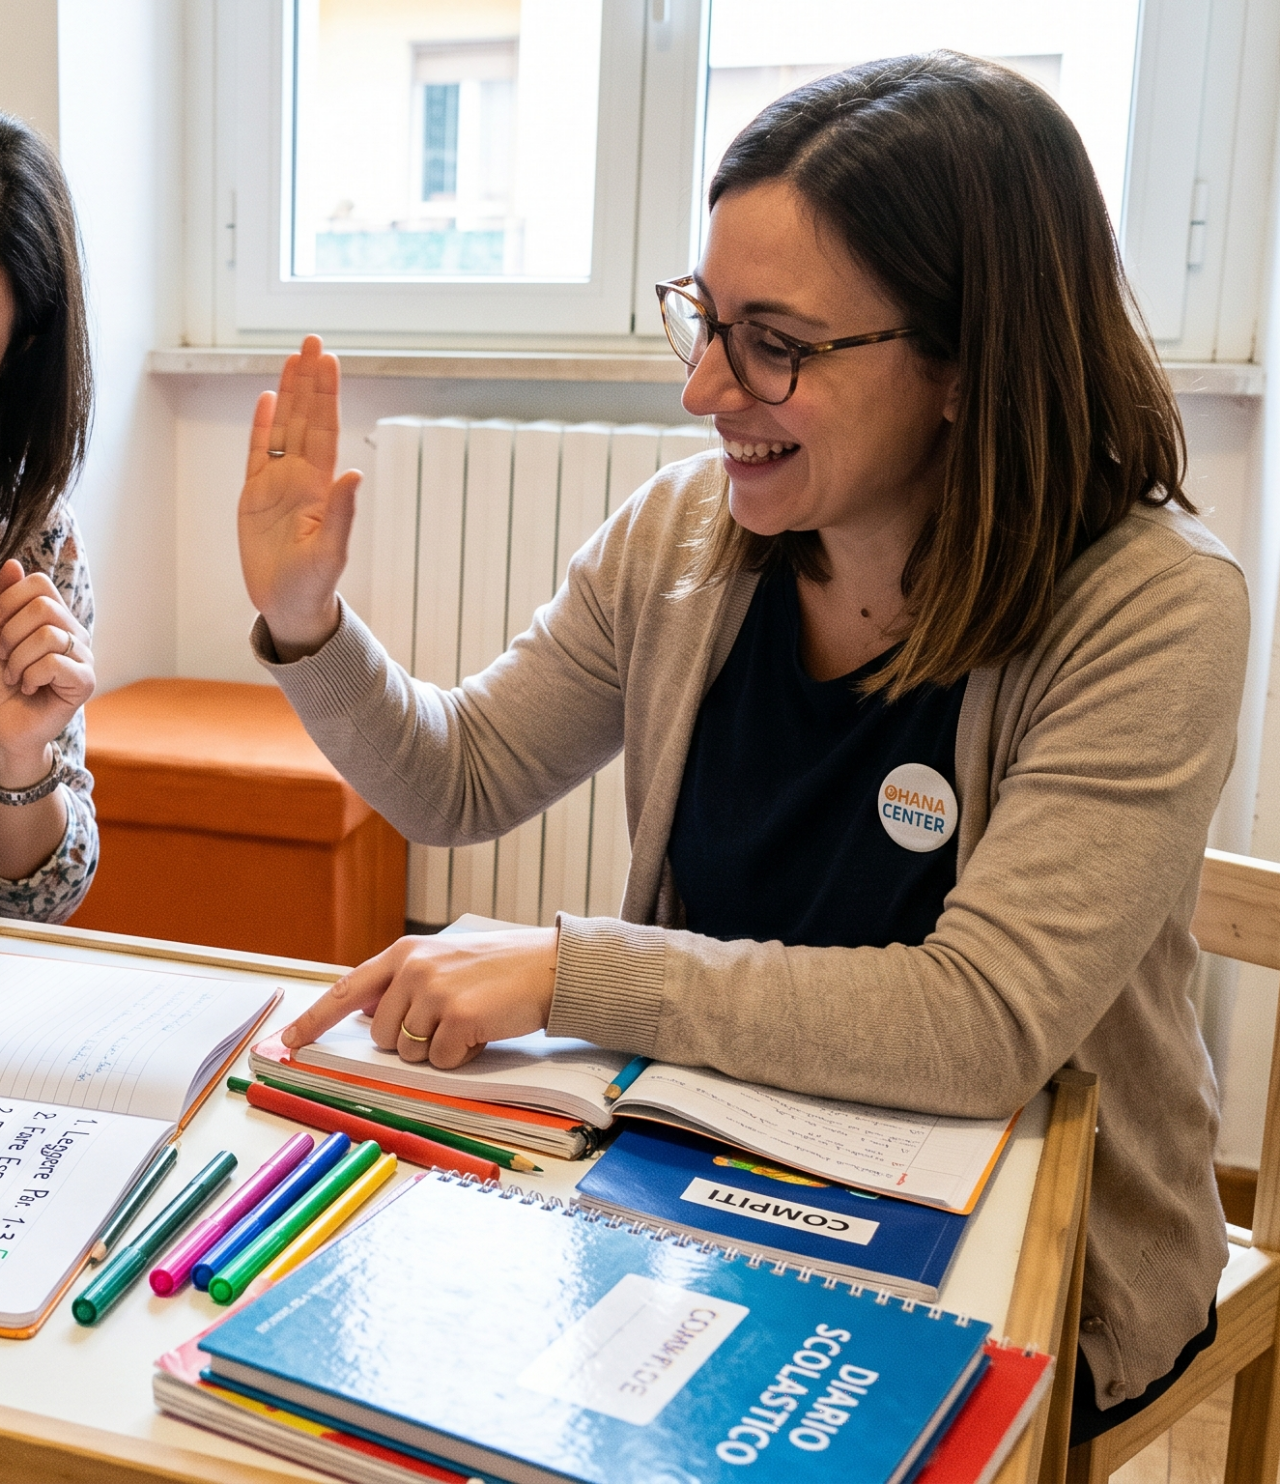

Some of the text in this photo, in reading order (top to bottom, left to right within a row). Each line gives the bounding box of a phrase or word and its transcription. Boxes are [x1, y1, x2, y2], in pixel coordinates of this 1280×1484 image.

[884, 784, 946, 815] OHANA
[882, 803, 945, 834] CENTER
[8, 1126, 47, 1151] Fare
[14, 1188, 50, 1208] Par.
[708, 1189, 850, 1232] COMPITI
[715, 1323, 852, 1465] SCOLASTICO
[788, 1364, 880, 1452] DIARIO
